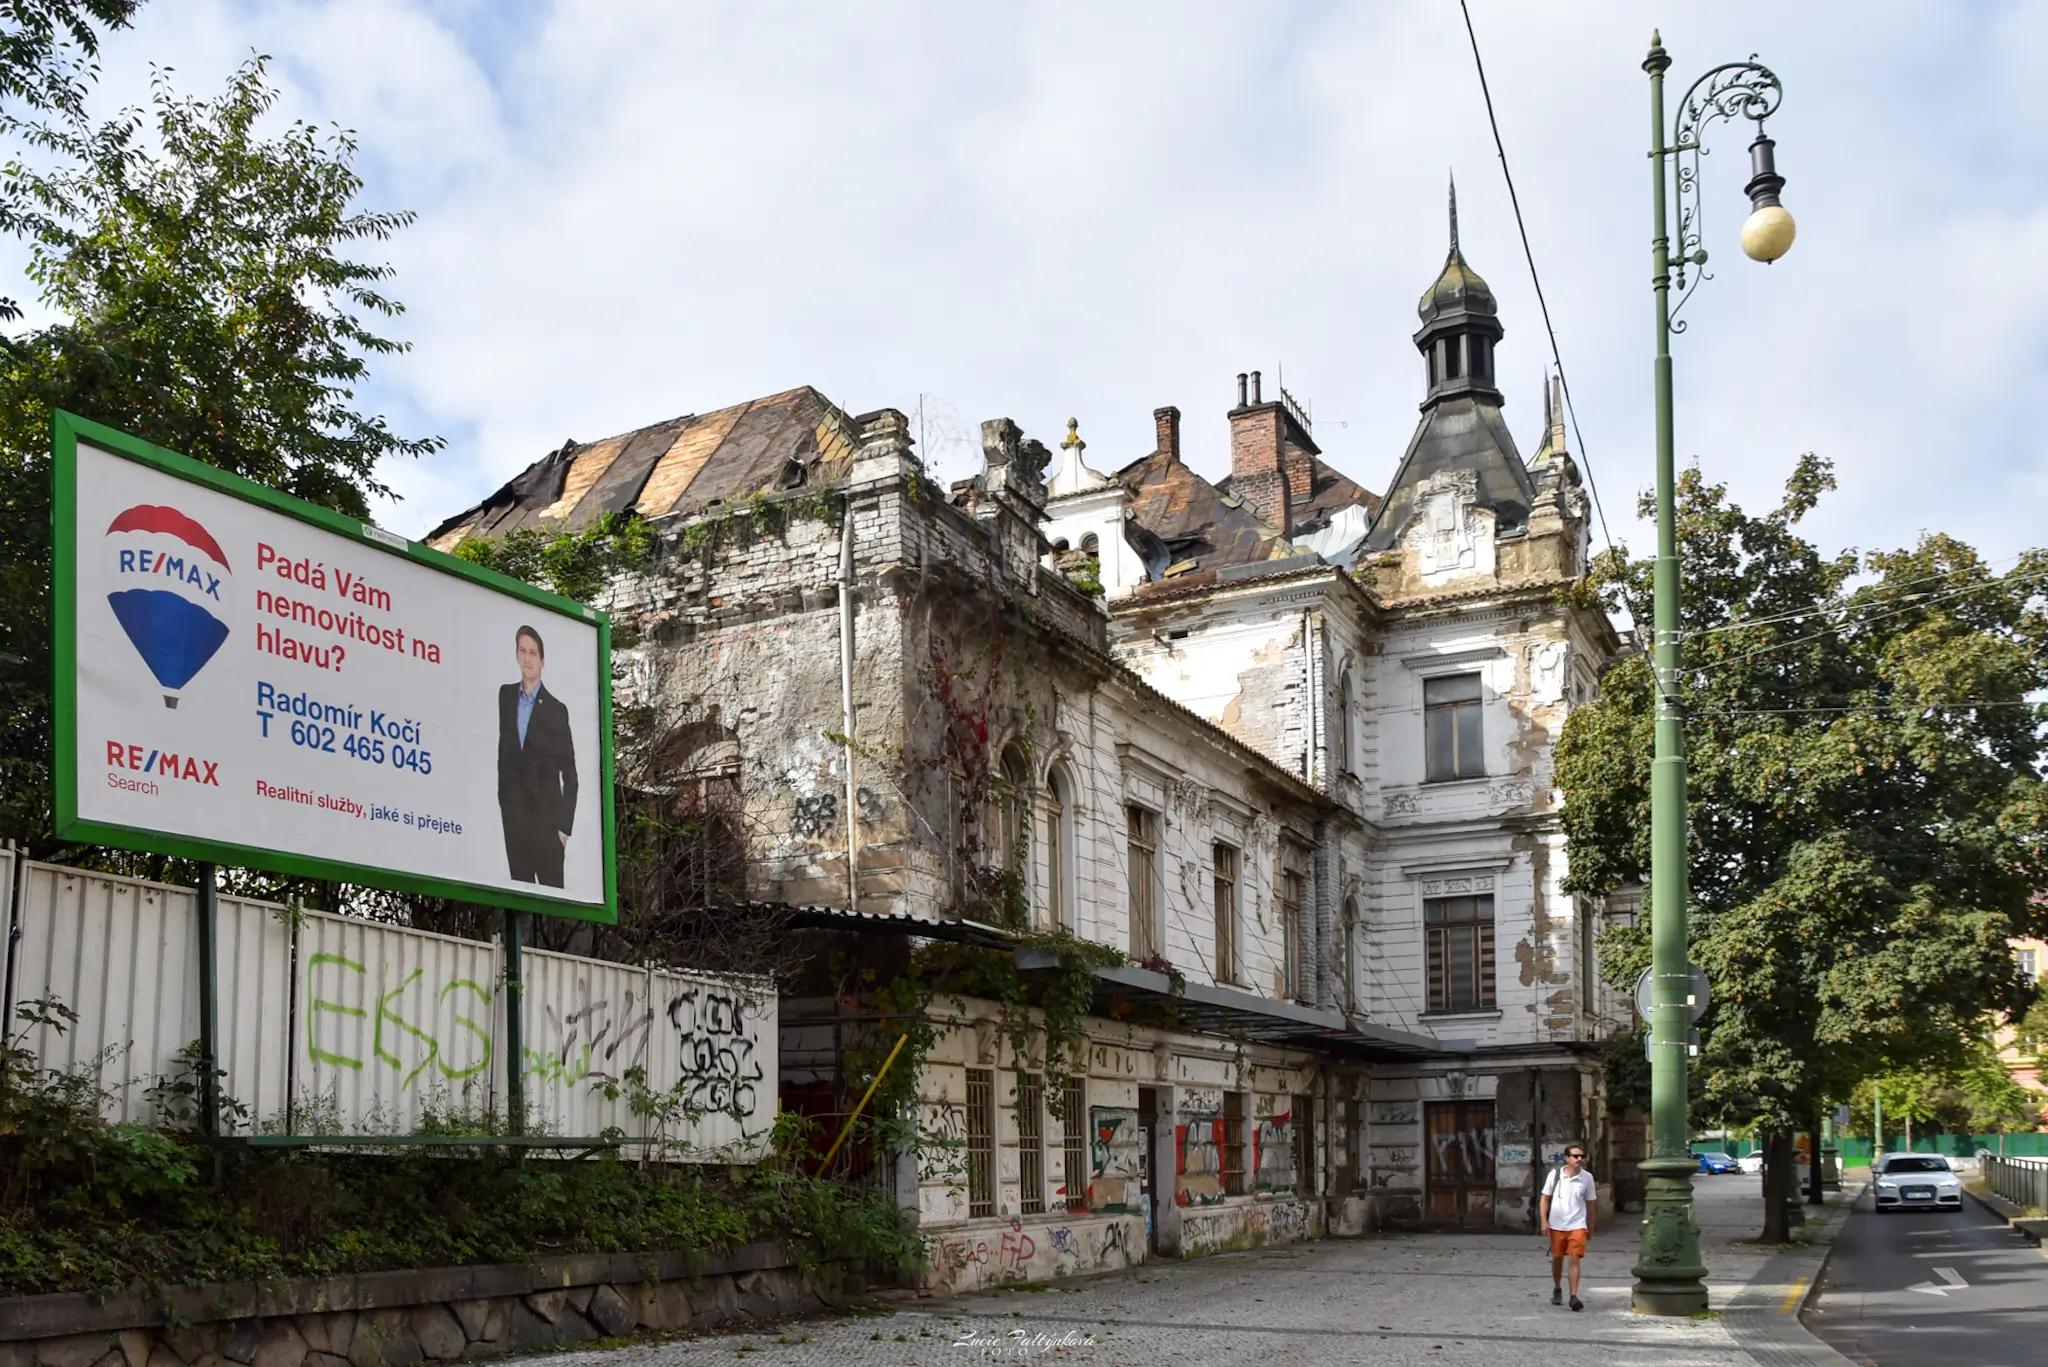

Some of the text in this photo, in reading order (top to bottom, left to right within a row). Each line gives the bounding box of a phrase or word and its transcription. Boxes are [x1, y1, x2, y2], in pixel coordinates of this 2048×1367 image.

[119, 549, 220, 602] RE/MAX
[257, 542, 391, 612] Padá Vám
[257, 589, 441, 664] nemovitost na
[257, 622, 345, 672] hlavu?
[257, 680, 421, 745] Radomír Kočí
[106, 740, 220, 787] RE/MAX
[256, 710, 432, 775] T 602 465 045
[107, 772, 159, 796] Search
[256, 780, 463, 836] Realitní služby, jaké si přejete
